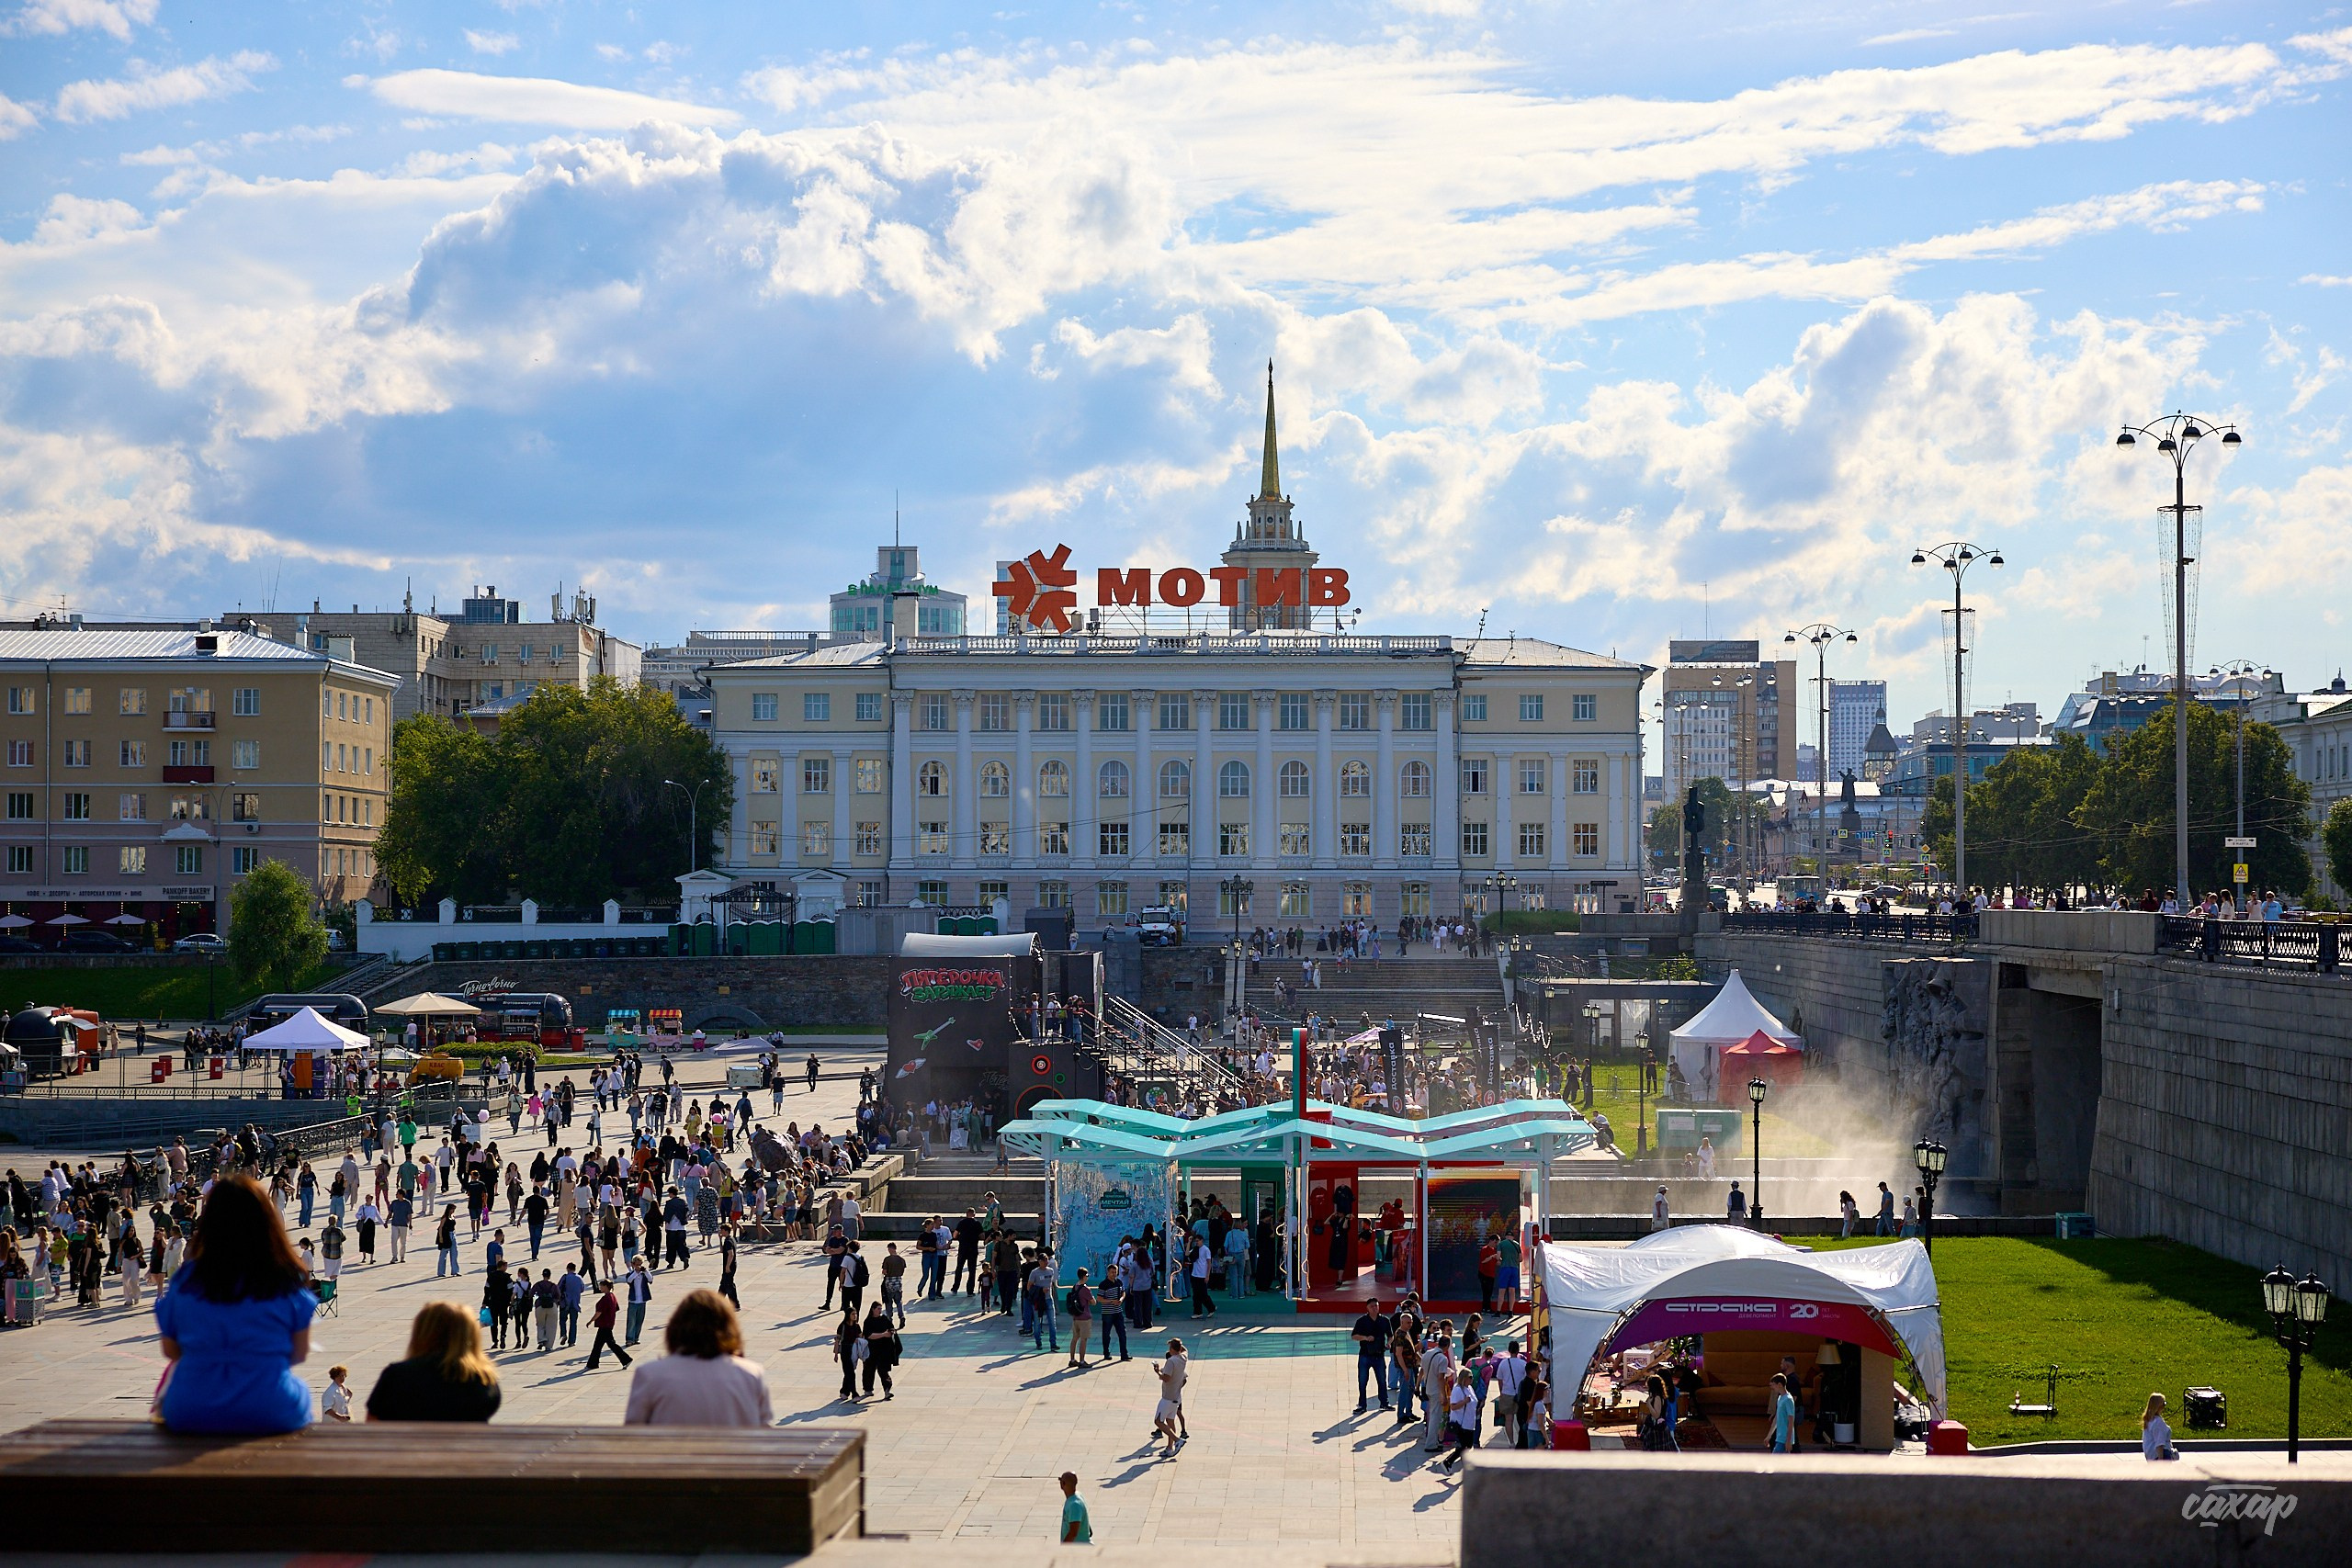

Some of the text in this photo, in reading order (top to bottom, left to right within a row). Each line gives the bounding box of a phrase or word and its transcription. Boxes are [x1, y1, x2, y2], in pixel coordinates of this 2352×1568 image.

[1098, 566, 1351, 607] МОТИВ
[900, 967, 1005, 992] ПЯТЁРОЧКА
[912, 985, 996, 1000] ЗАРЯЖАЕТ
[1790, 1303, 1819, 1319] 20
